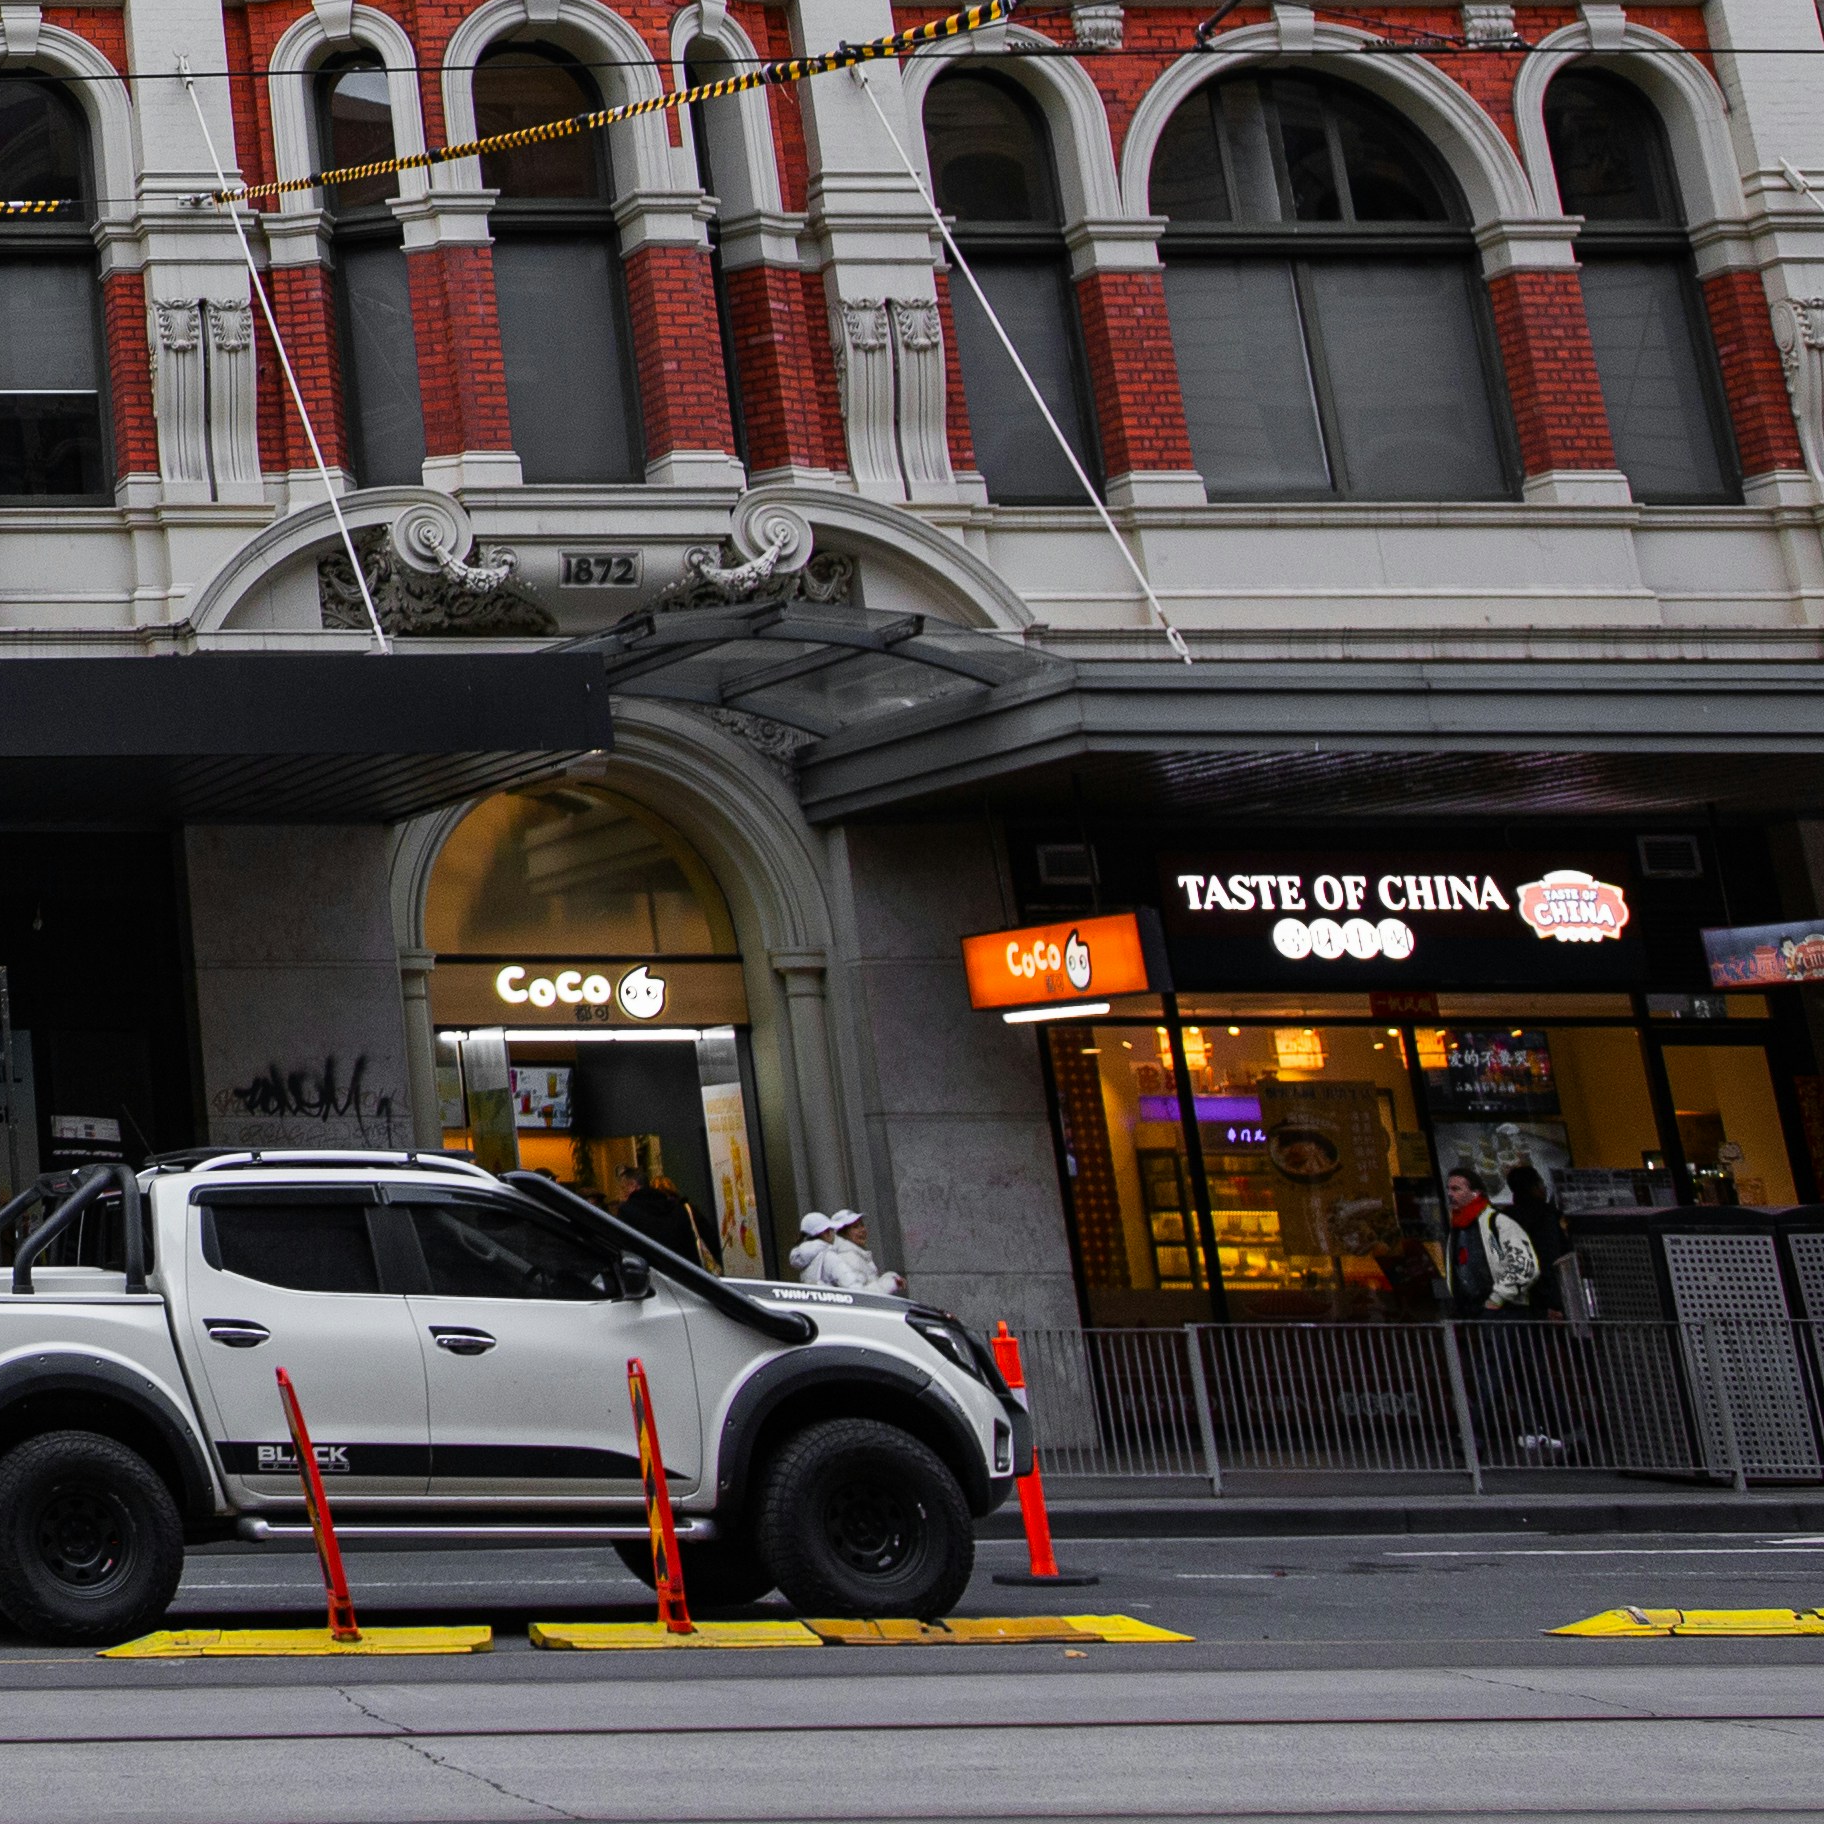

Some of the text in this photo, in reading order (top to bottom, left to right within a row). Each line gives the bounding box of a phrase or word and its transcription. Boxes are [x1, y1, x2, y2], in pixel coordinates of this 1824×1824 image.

[563, 558, 635, 585] 1872
[1178, 875, 1510, 912] TASTE OF CHINA
[1542, 888, 1598, 901] TASTE OF
[1534, 901, 1616, 927] CHINA
[1006, 940, 1061, 979] CoCo
[496, 965, 611, 1008] CoCo
[772, 1288, 854, 1305] TWIN/TURBO
[257, 1445, 349, 1462] BLCK
